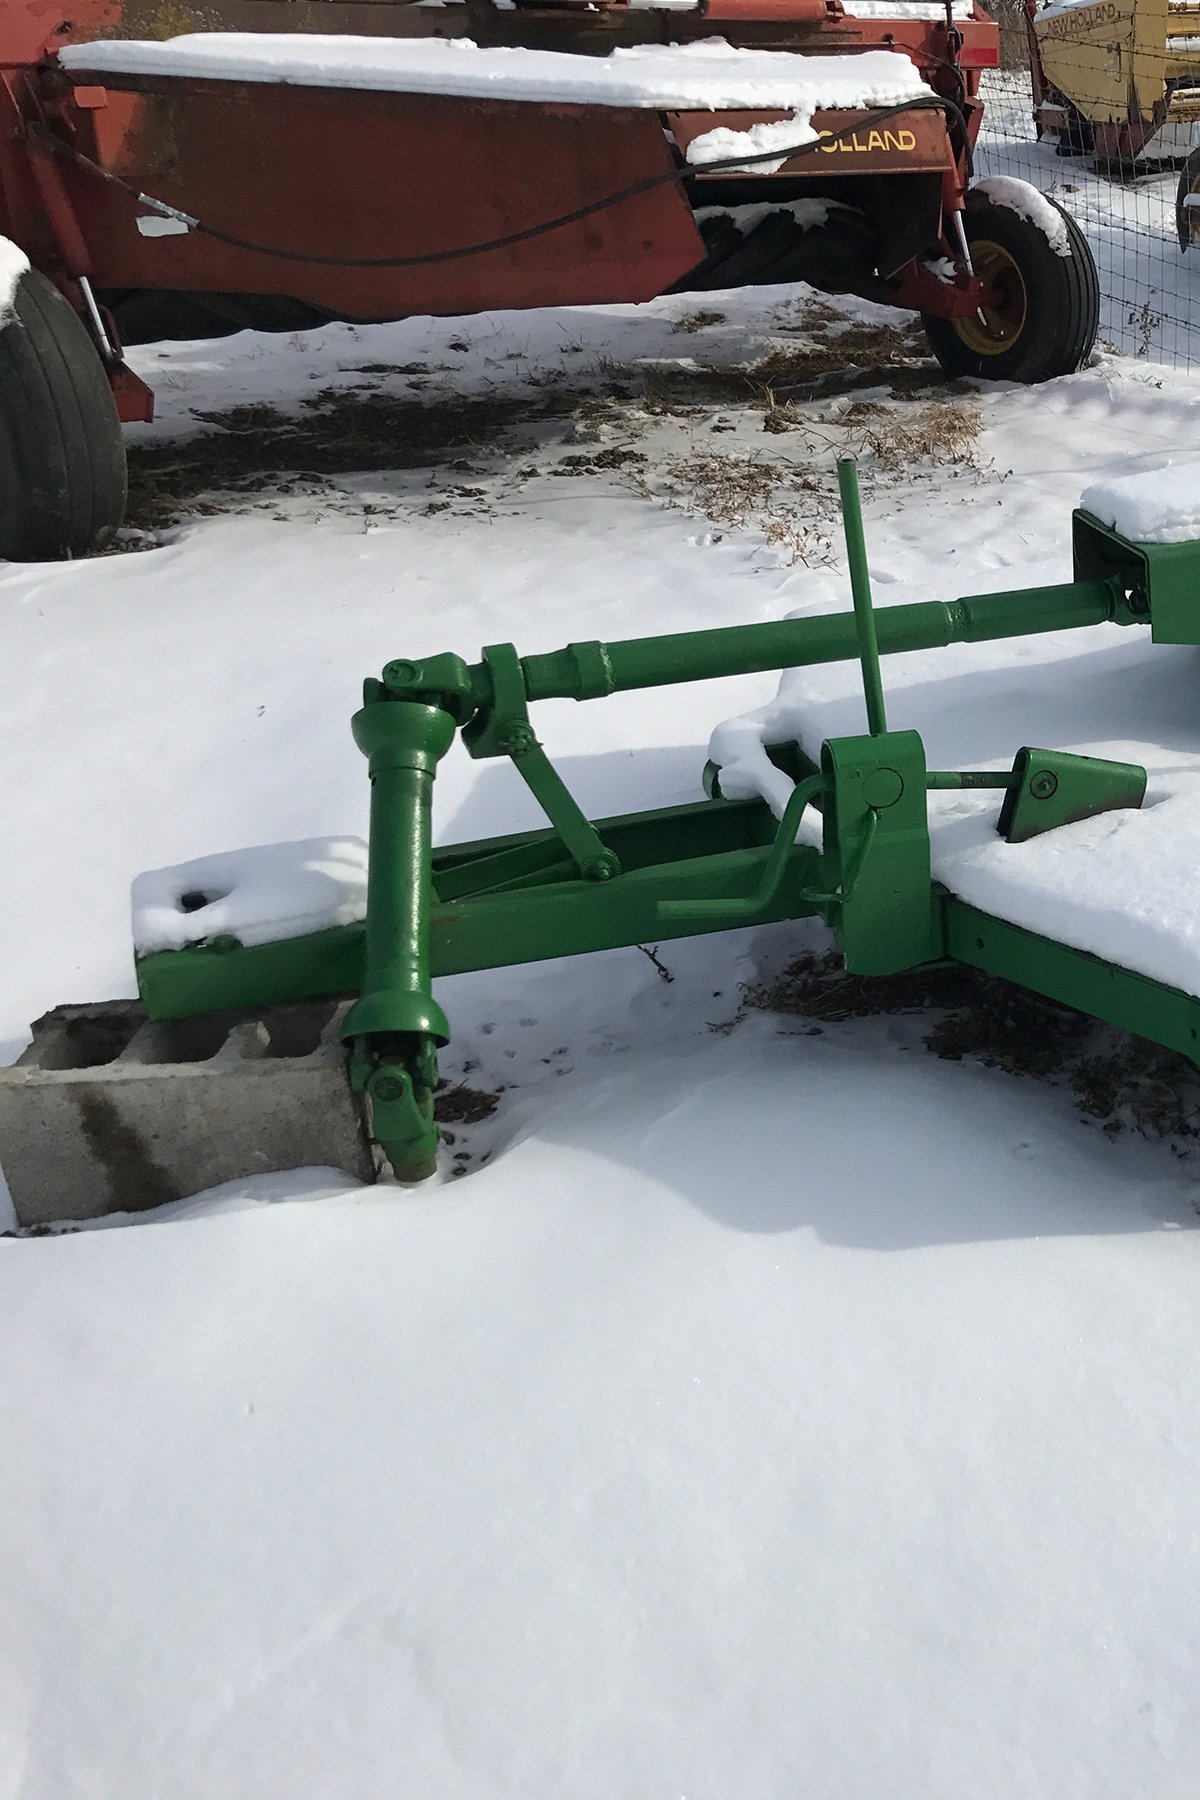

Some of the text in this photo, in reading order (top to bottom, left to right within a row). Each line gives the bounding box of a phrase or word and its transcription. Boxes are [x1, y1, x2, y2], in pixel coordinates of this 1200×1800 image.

[1047, 3, 1116, 35] NEW HOLLAND
[814, 130, 916, 153] OLLAND
